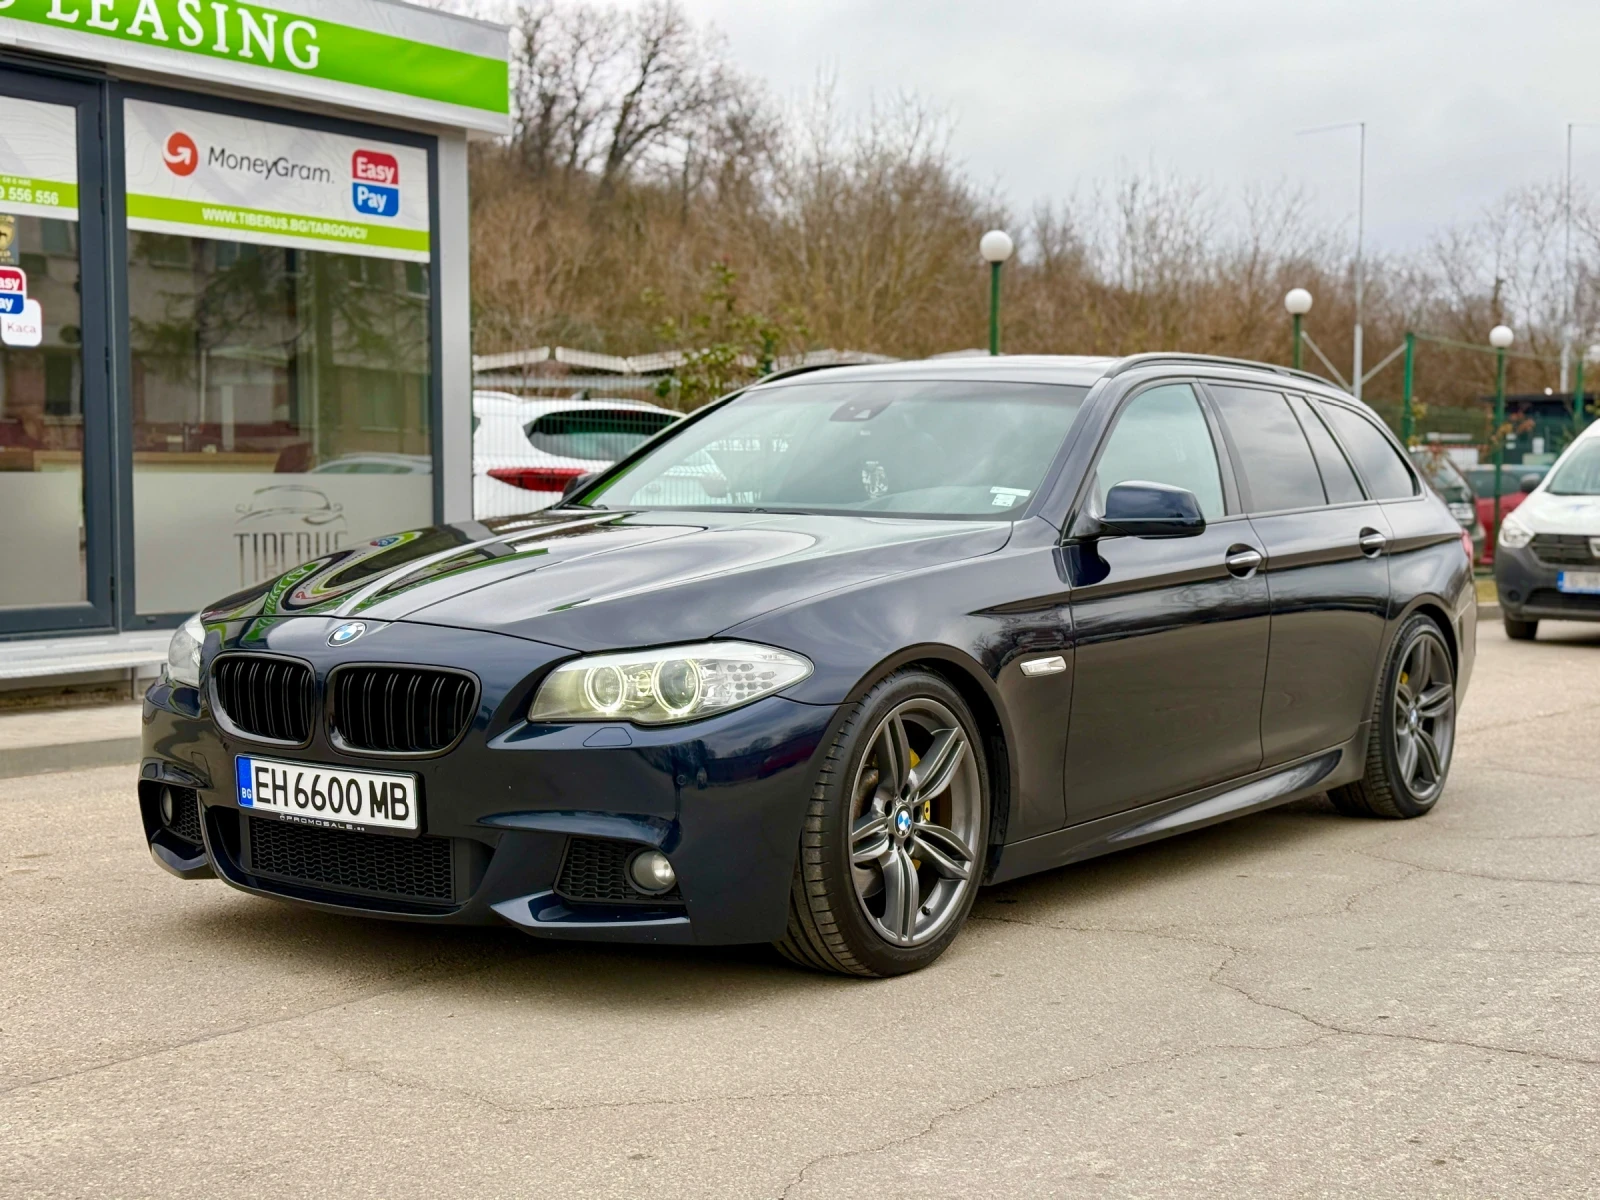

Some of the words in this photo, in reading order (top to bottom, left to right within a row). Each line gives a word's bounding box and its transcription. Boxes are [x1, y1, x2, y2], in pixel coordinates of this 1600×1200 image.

[356, 156, 395, 184] Easy
[8, 187, 33, 202] 556
[36, 190, 59, 206] 556
[357, 185, 387, 213] Pay
[241, 787, 252, 799] BG
[255, 766, 288, 807] EH
[294, 772, 363, 816] 6600
[369, 780, 409, 821] MB
